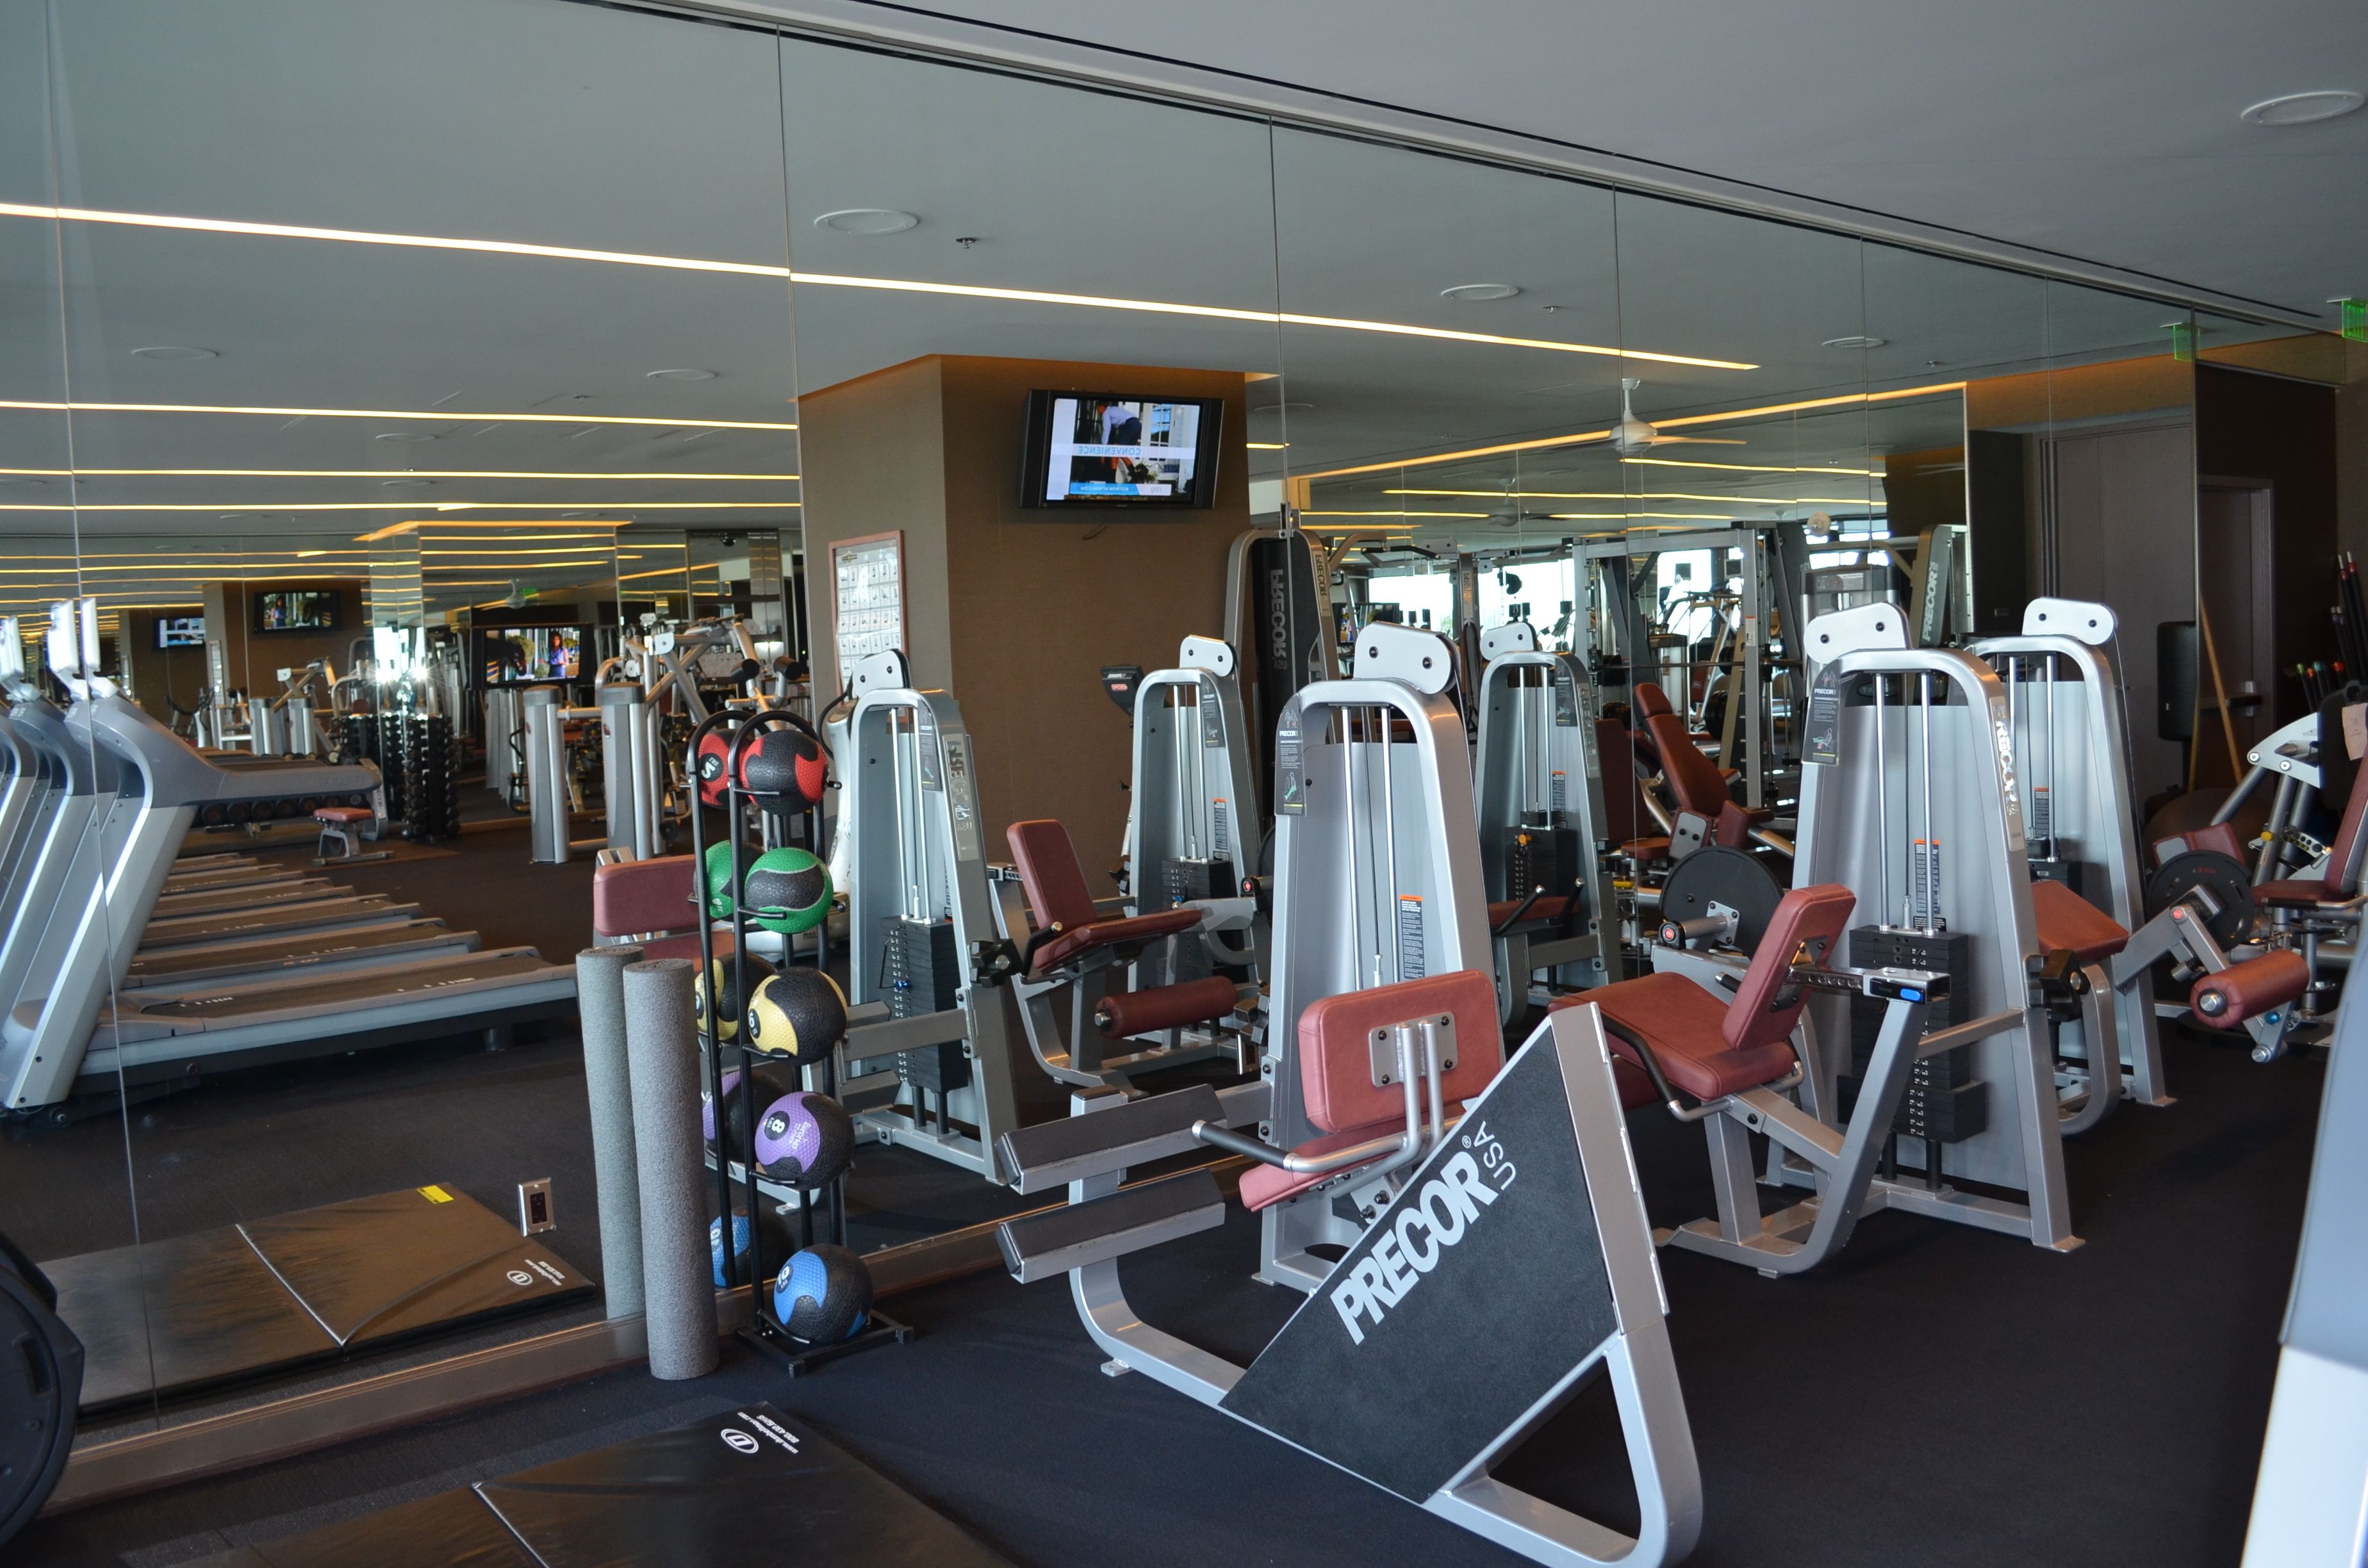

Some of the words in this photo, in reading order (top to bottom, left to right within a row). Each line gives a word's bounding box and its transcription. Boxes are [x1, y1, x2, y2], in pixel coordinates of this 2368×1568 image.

[1922, 571, 1937, 642] PRECOR
[749, 1012, 755, 1028] 6
[771, 1119, 785, 1133] 8
[1474, 1120, 1517, 1191] USA
[1330, 1150, 1499, 1346] PRECOR
